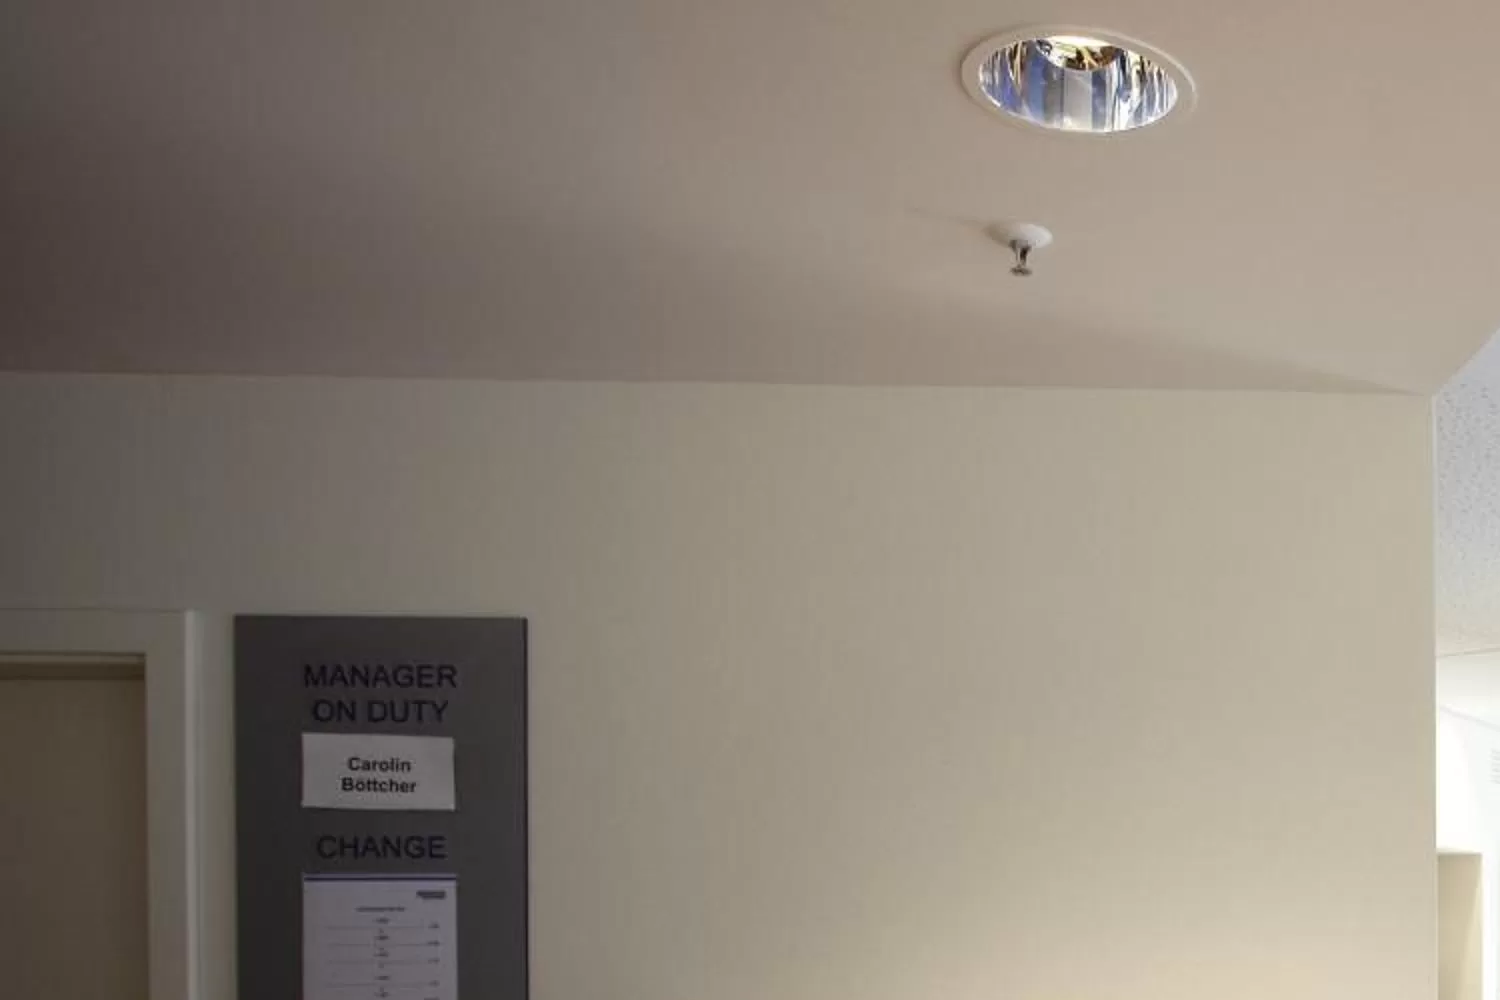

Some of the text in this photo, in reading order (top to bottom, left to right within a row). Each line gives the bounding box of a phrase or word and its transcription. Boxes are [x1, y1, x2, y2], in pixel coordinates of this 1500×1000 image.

[304, 664, 458, 688] MANAGER
[312, 698, 448, 723] ON DUTY
[347, 756, 411, 772] Carolin
[316, 835, 448, 860] CHANGE
